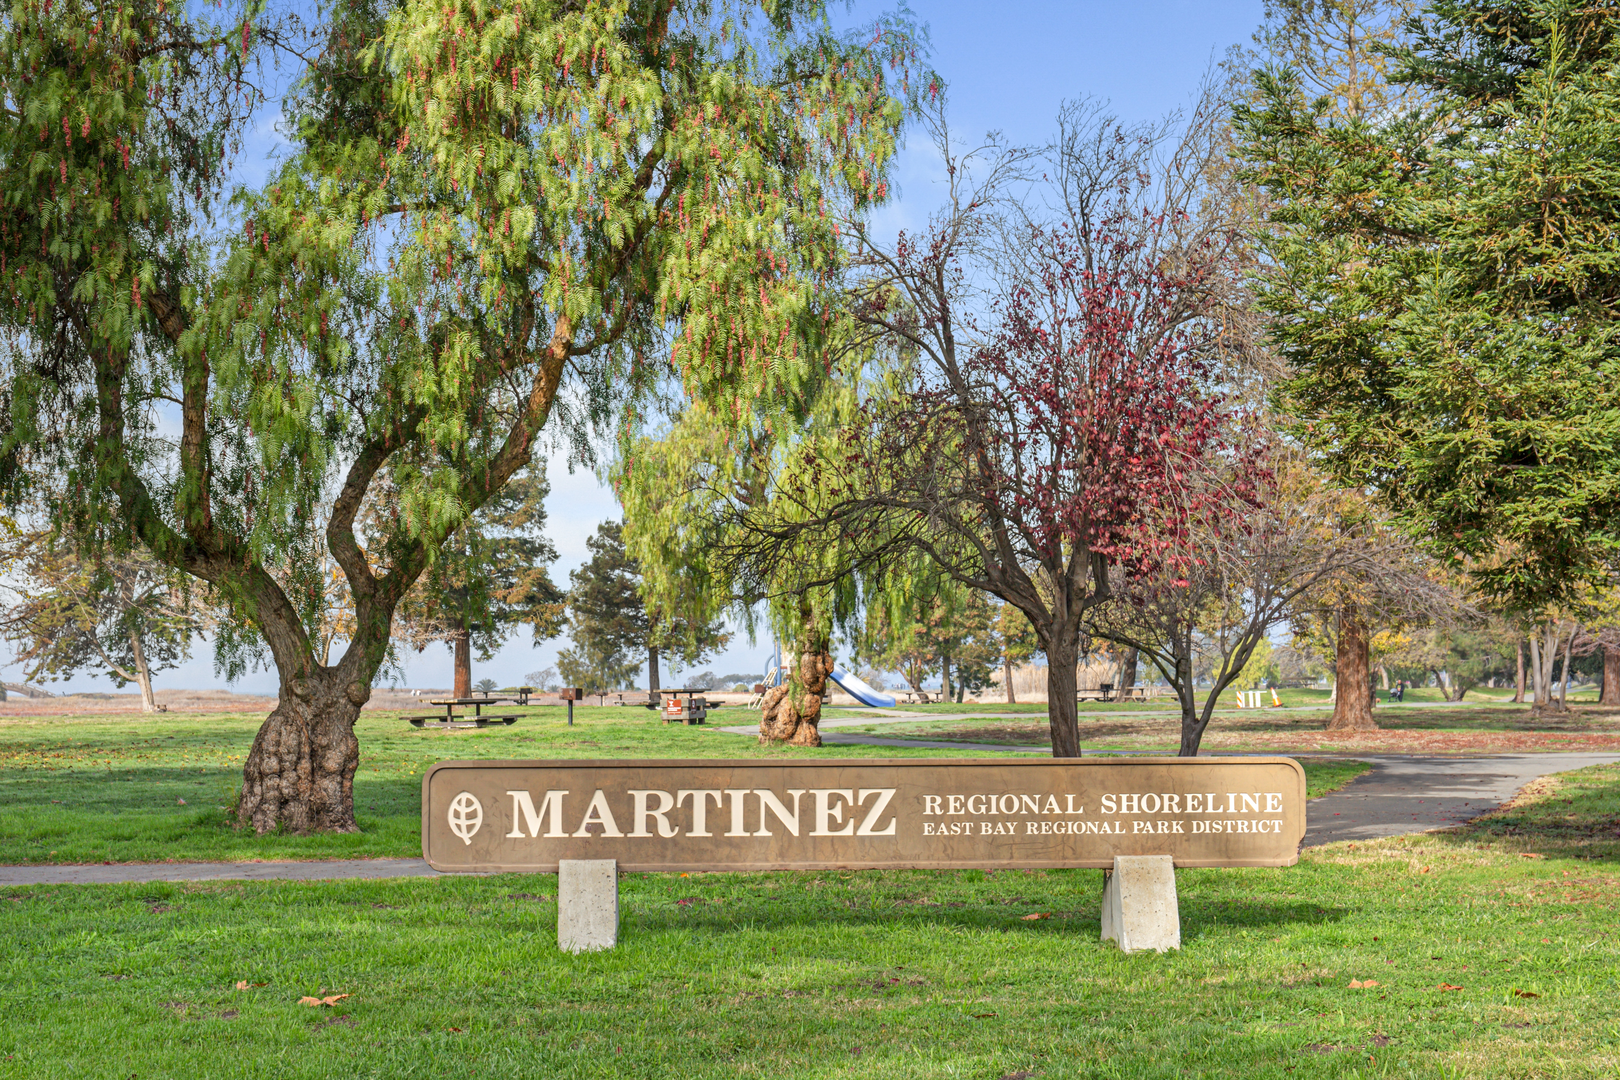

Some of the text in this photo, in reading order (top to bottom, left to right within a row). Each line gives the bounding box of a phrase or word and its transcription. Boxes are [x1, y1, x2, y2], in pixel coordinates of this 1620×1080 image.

[506, 788, 897, 839] MARTINEZ
[922, 792, 1283, 815] REGIONAL SHORELINE
[922, 819, 1284, 836] EAST BAY REGIONAL PARK DISTRICT
